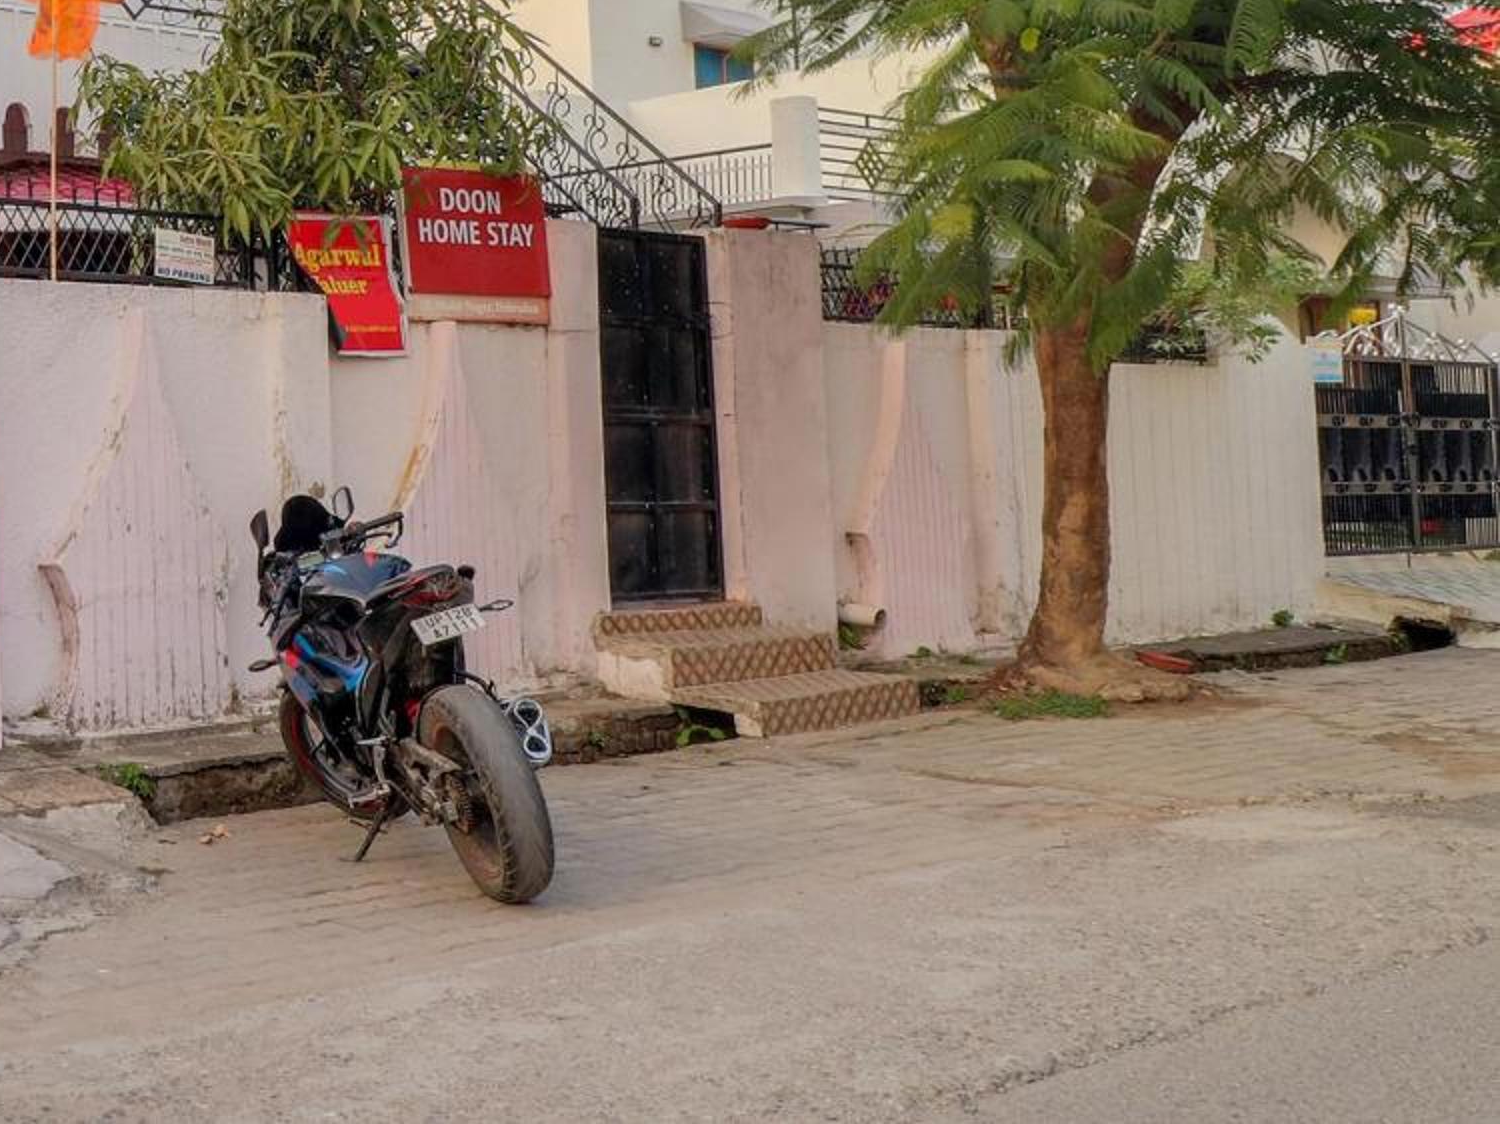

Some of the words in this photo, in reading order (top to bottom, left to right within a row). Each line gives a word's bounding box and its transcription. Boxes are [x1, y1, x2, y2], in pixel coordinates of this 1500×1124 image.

[439, 187, 501, 215] DOON
[418, 219, 481, 246] HOME
[487, 222, 534, 248] STAY
[294, 242, 382, 272] Agarwal
